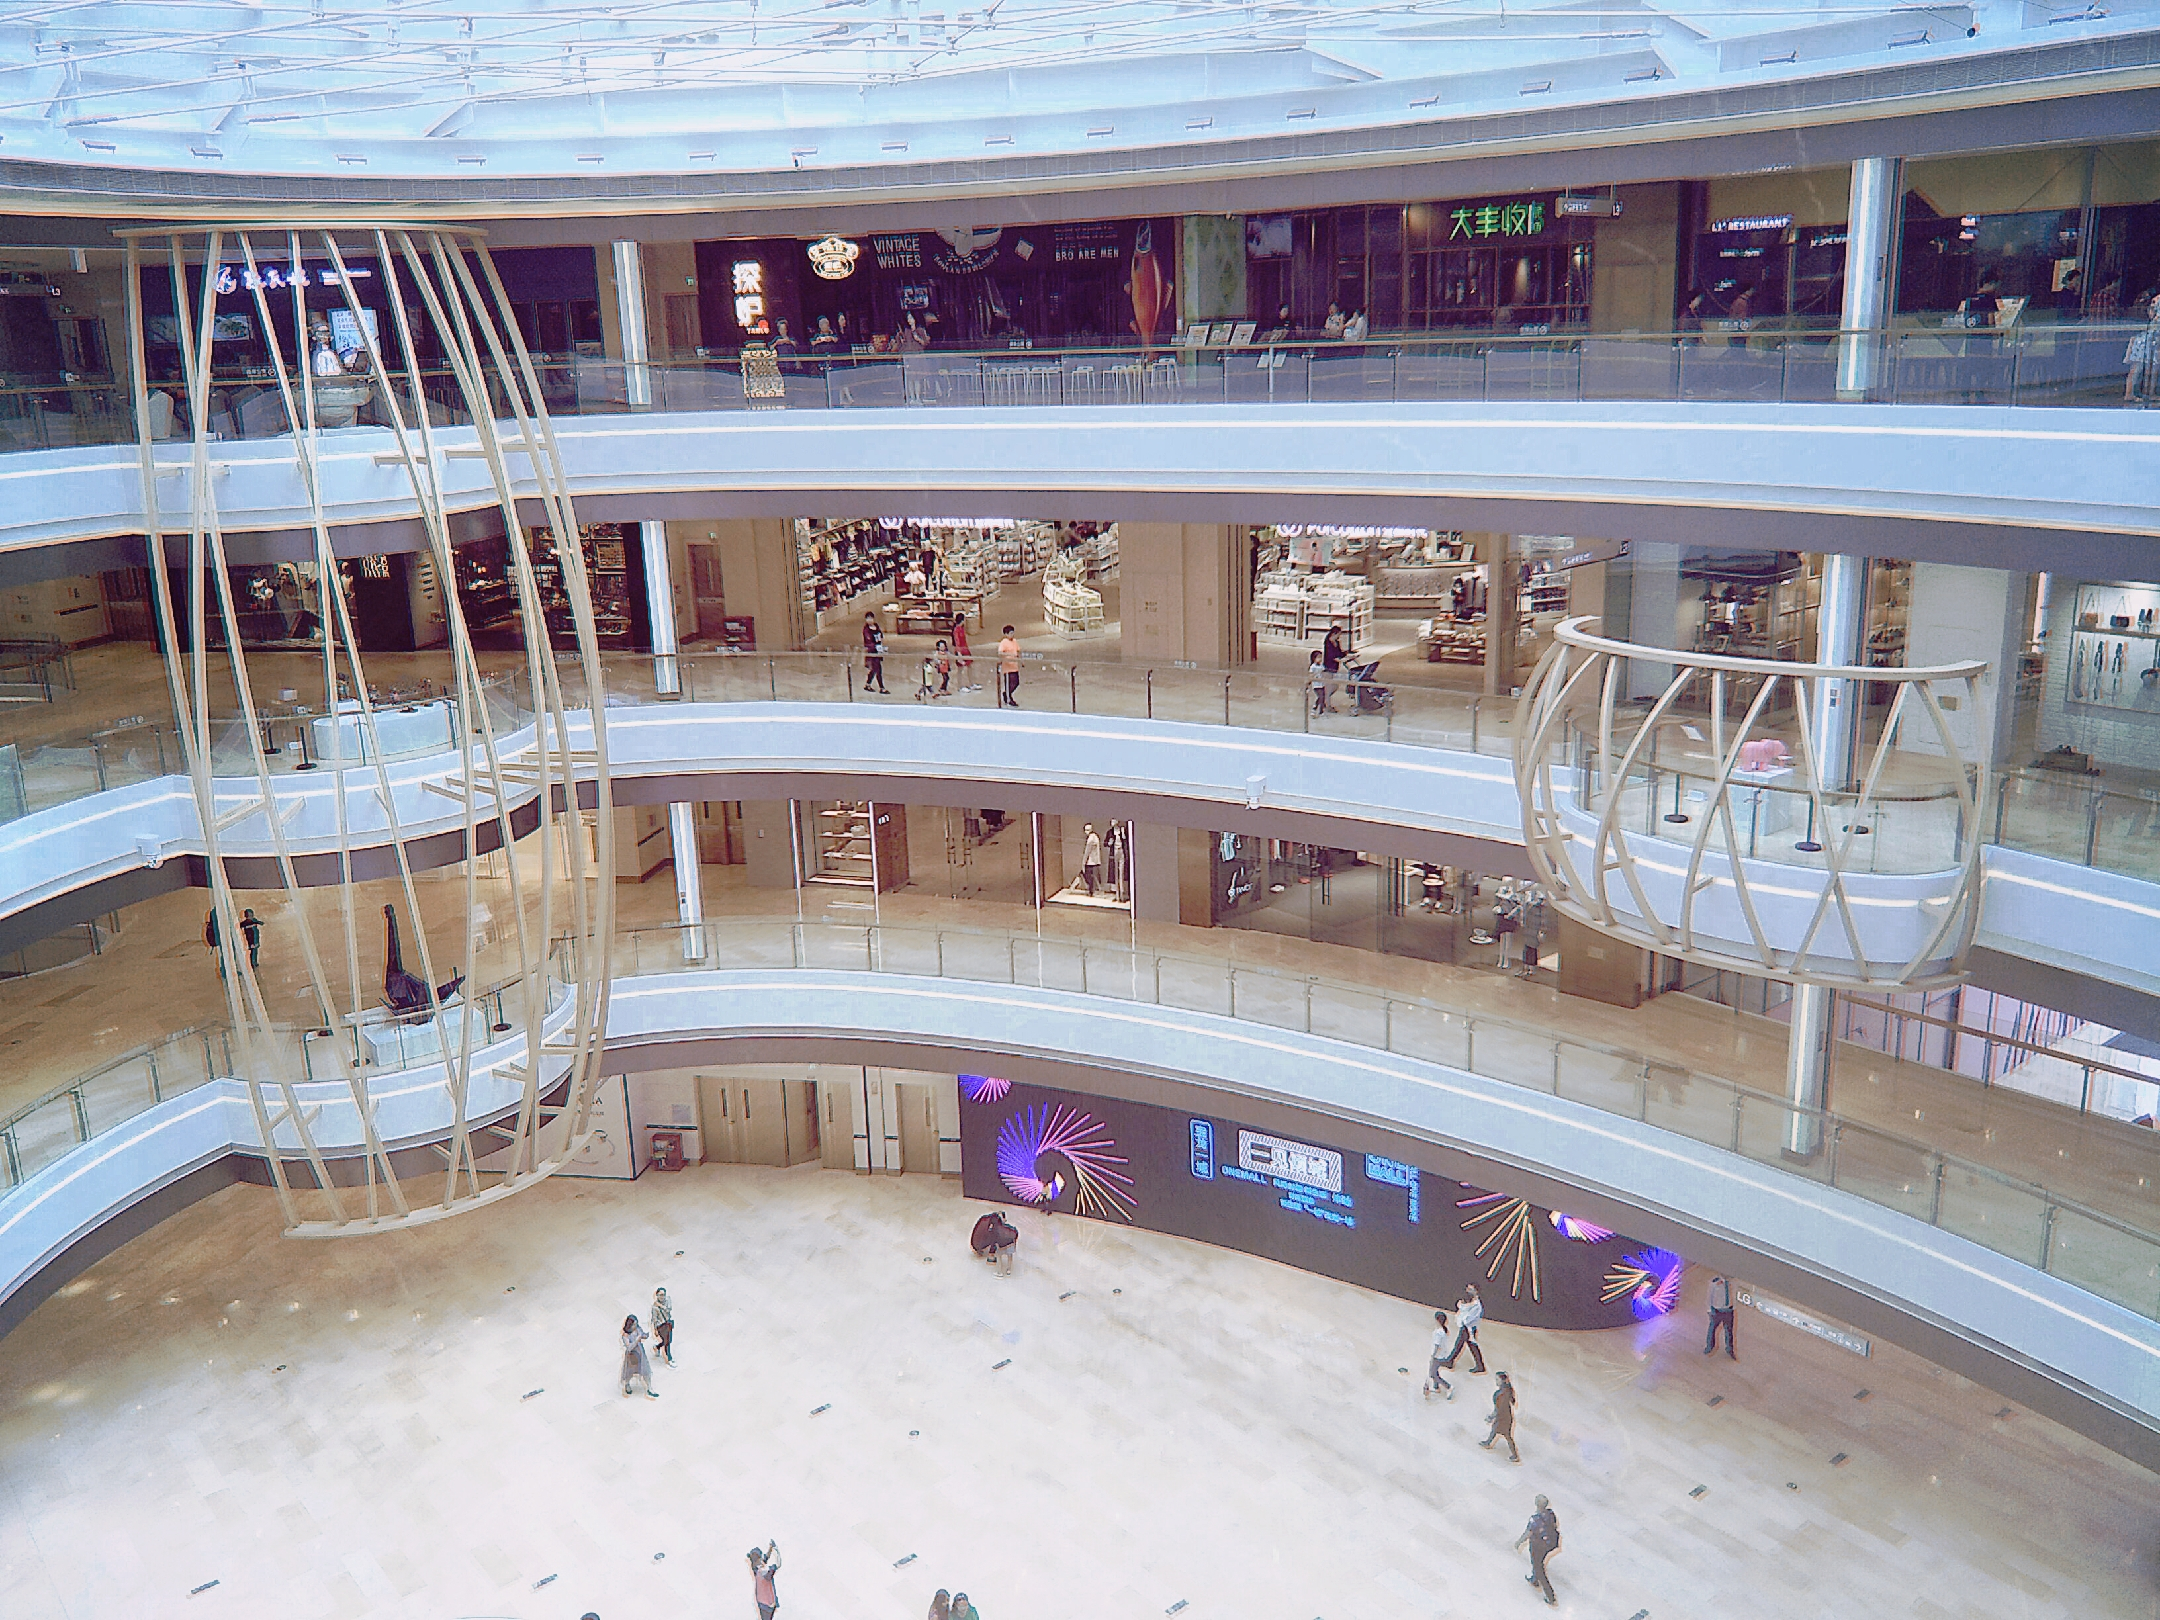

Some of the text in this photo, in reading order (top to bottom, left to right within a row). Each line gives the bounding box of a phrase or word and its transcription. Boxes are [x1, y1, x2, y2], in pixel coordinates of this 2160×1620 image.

[1449, 203, 1528, 241] 大丰收
[1728, 217, 1791, 231] RESTAURANT
[873, 235, 920, 254] VINTAGE
[876, 253, 922, 270] WHITES
[1055, 246, 1119, 262] BRO ARE MEN
[1368, 1163, 1407, 1183] MALL
[1736, 1291, 1752, 1305] LG
